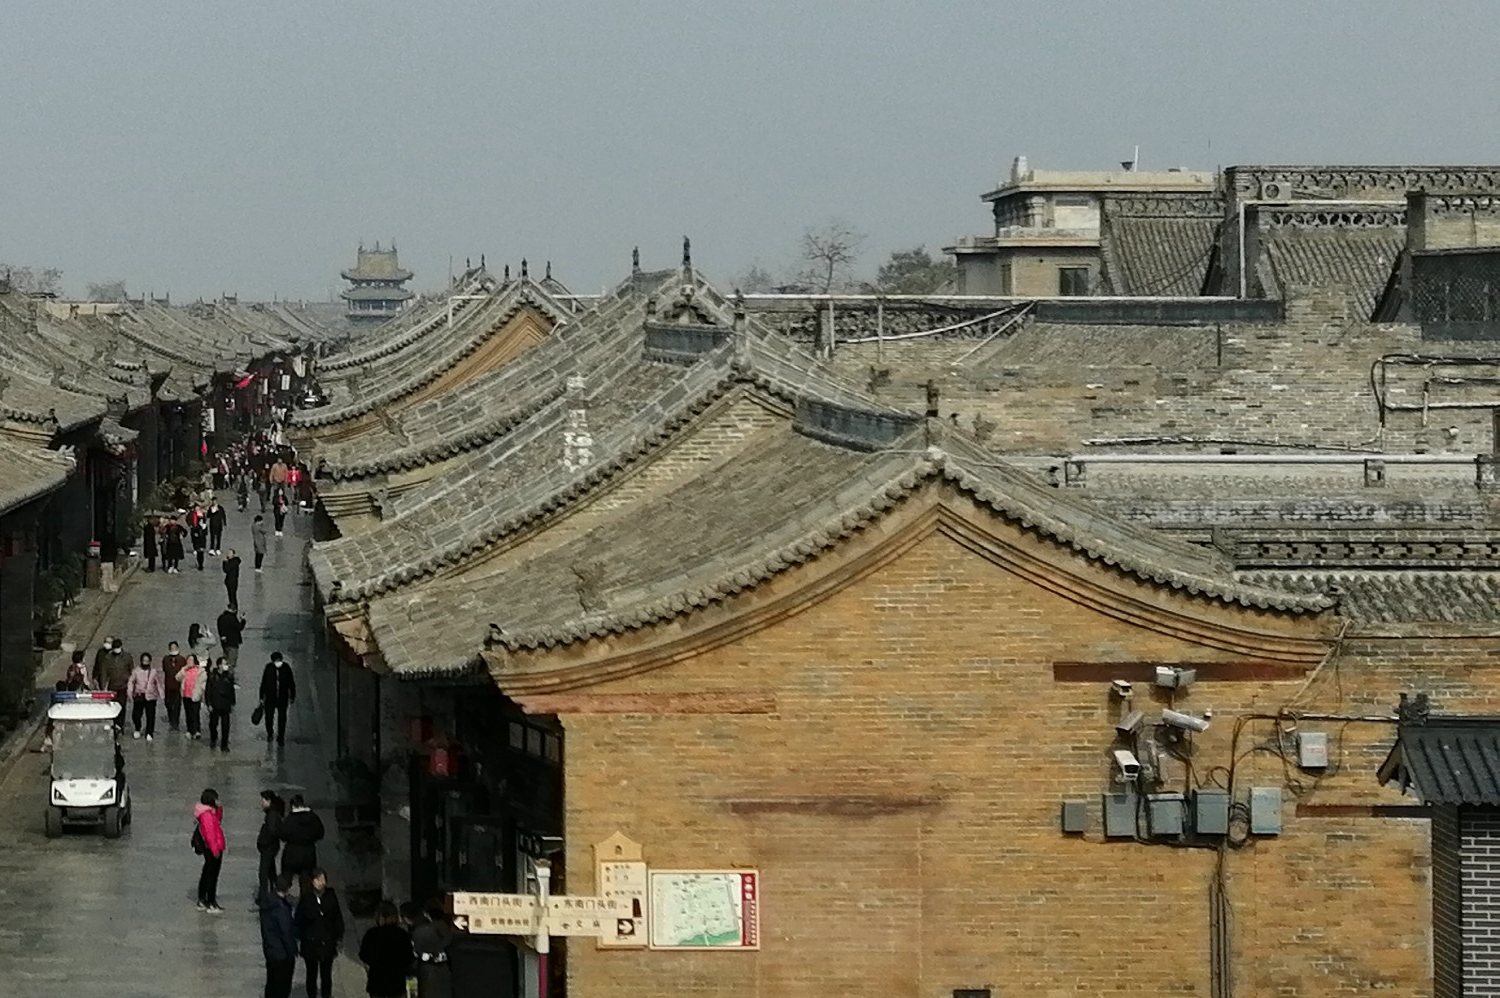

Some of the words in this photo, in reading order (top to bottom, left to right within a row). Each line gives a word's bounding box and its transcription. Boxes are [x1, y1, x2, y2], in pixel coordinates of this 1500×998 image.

[469, 896, 522, 907] 西南门头街
[564, 899, 618, 910] 东南门头街
